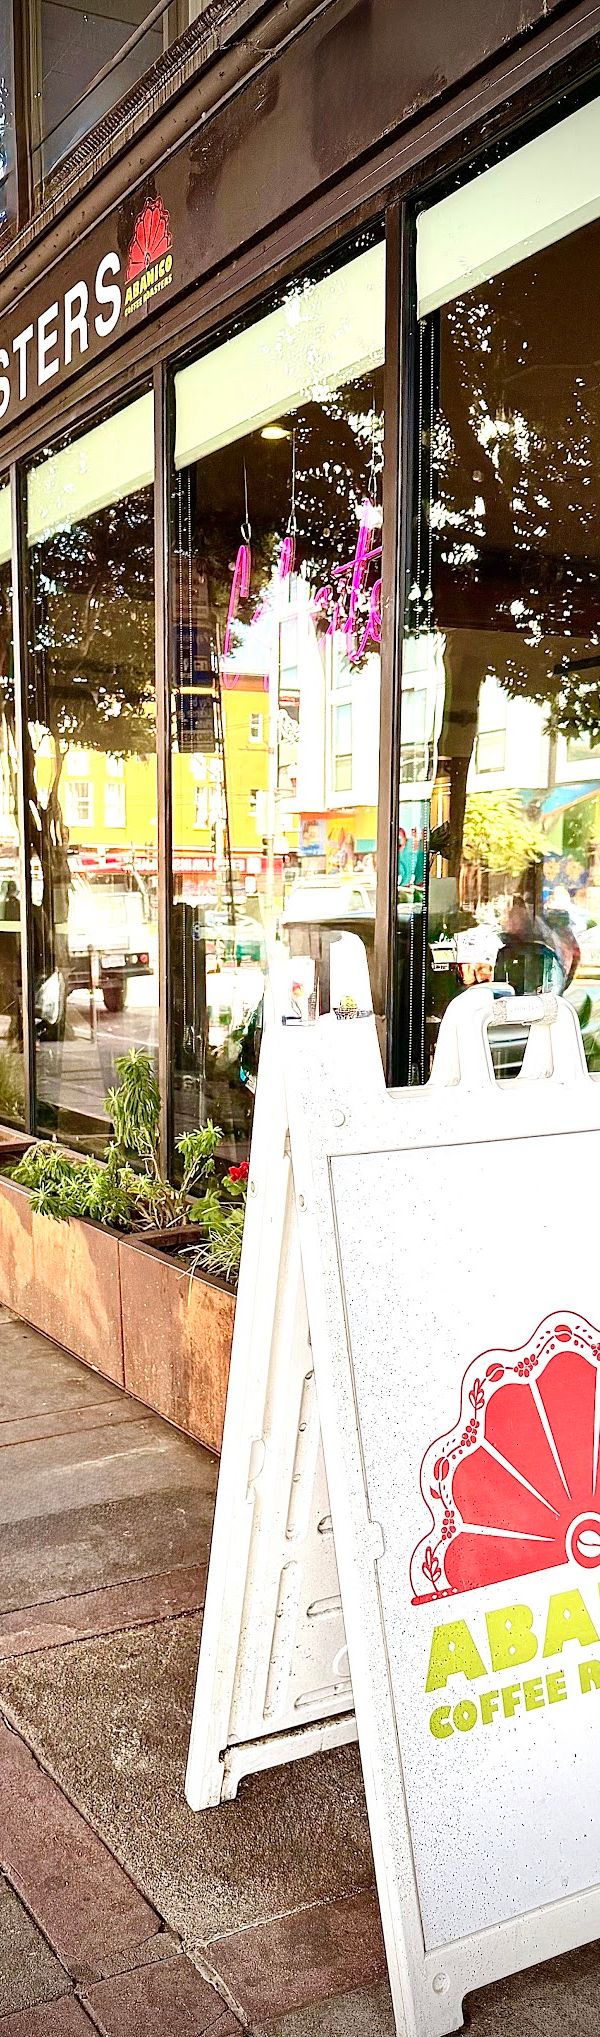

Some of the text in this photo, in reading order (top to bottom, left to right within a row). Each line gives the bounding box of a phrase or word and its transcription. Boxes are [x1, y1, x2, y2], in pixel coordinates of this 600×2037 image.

[125, 254, 173, 306] ABANICO
[425, 1582, 600, 1693] ABA
[429, 1670, 568, 1739] COFFEE
